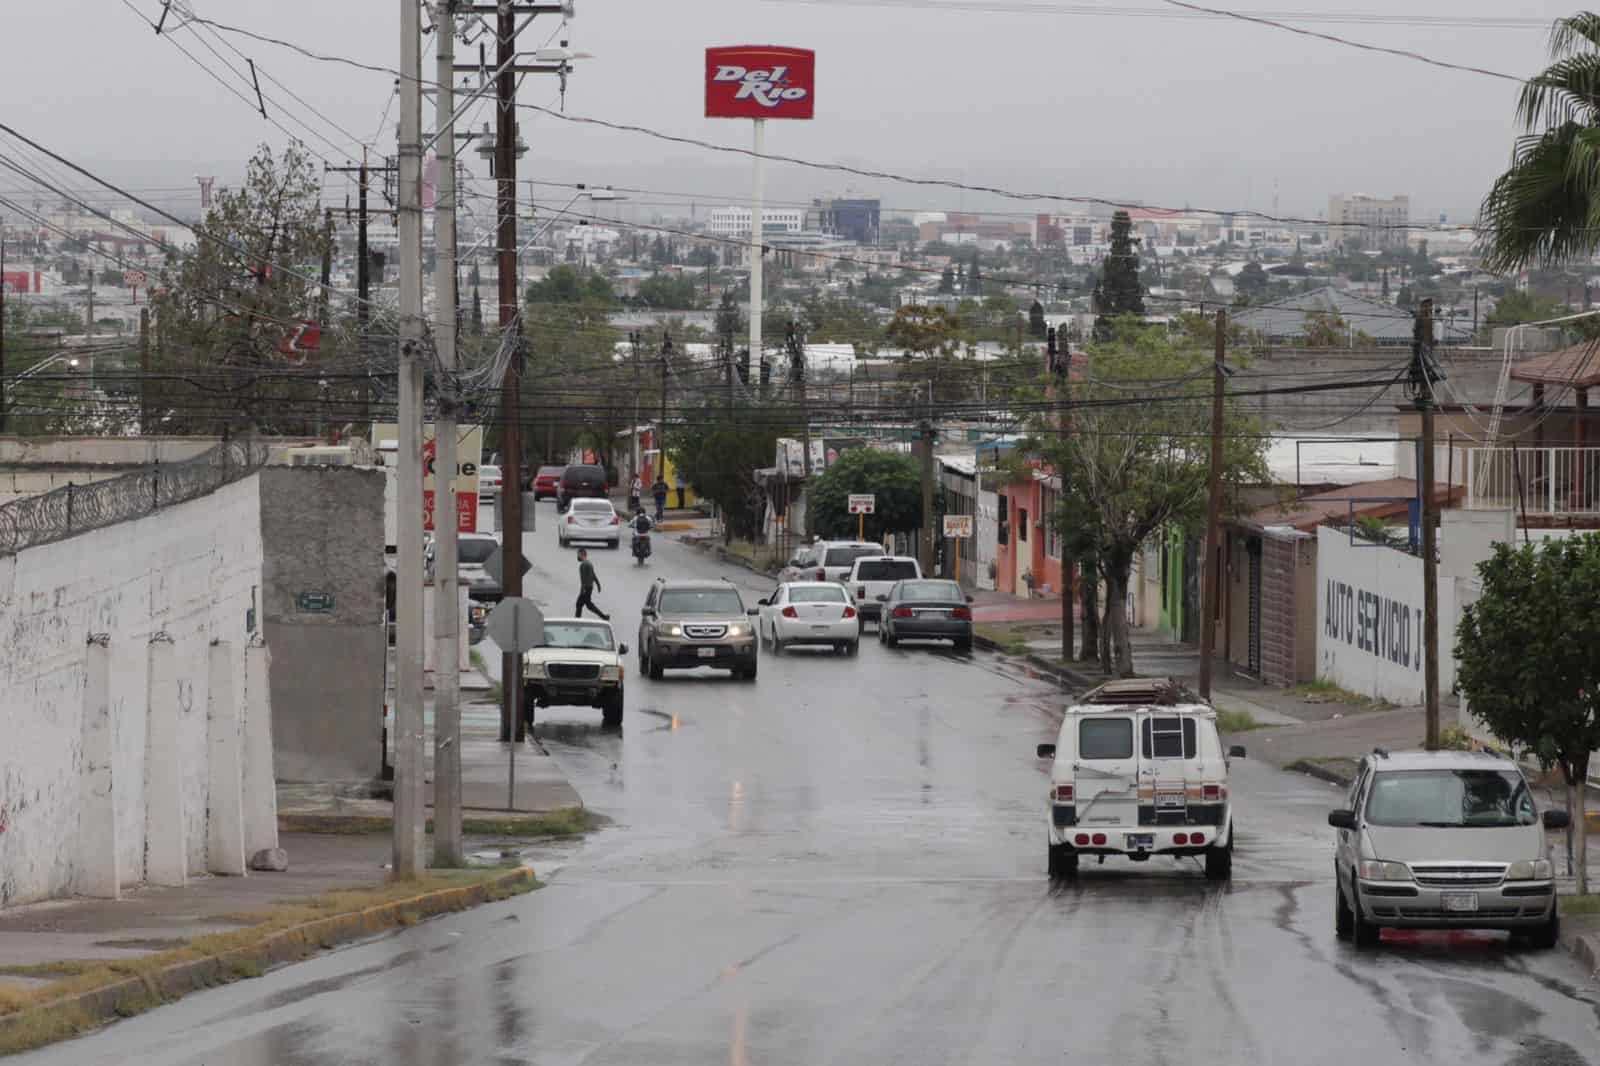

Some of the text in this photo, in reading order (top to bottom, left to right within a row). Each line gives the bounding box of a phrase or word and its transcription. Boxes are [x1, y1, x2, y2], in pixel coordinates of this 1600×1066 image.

[713, 65, 786, 82] Del
[734, 80, 807, 107] Rio
[1324, 578, 1353, 645] AUTO
[1357, 588, 1410, 668] SERVICIO
